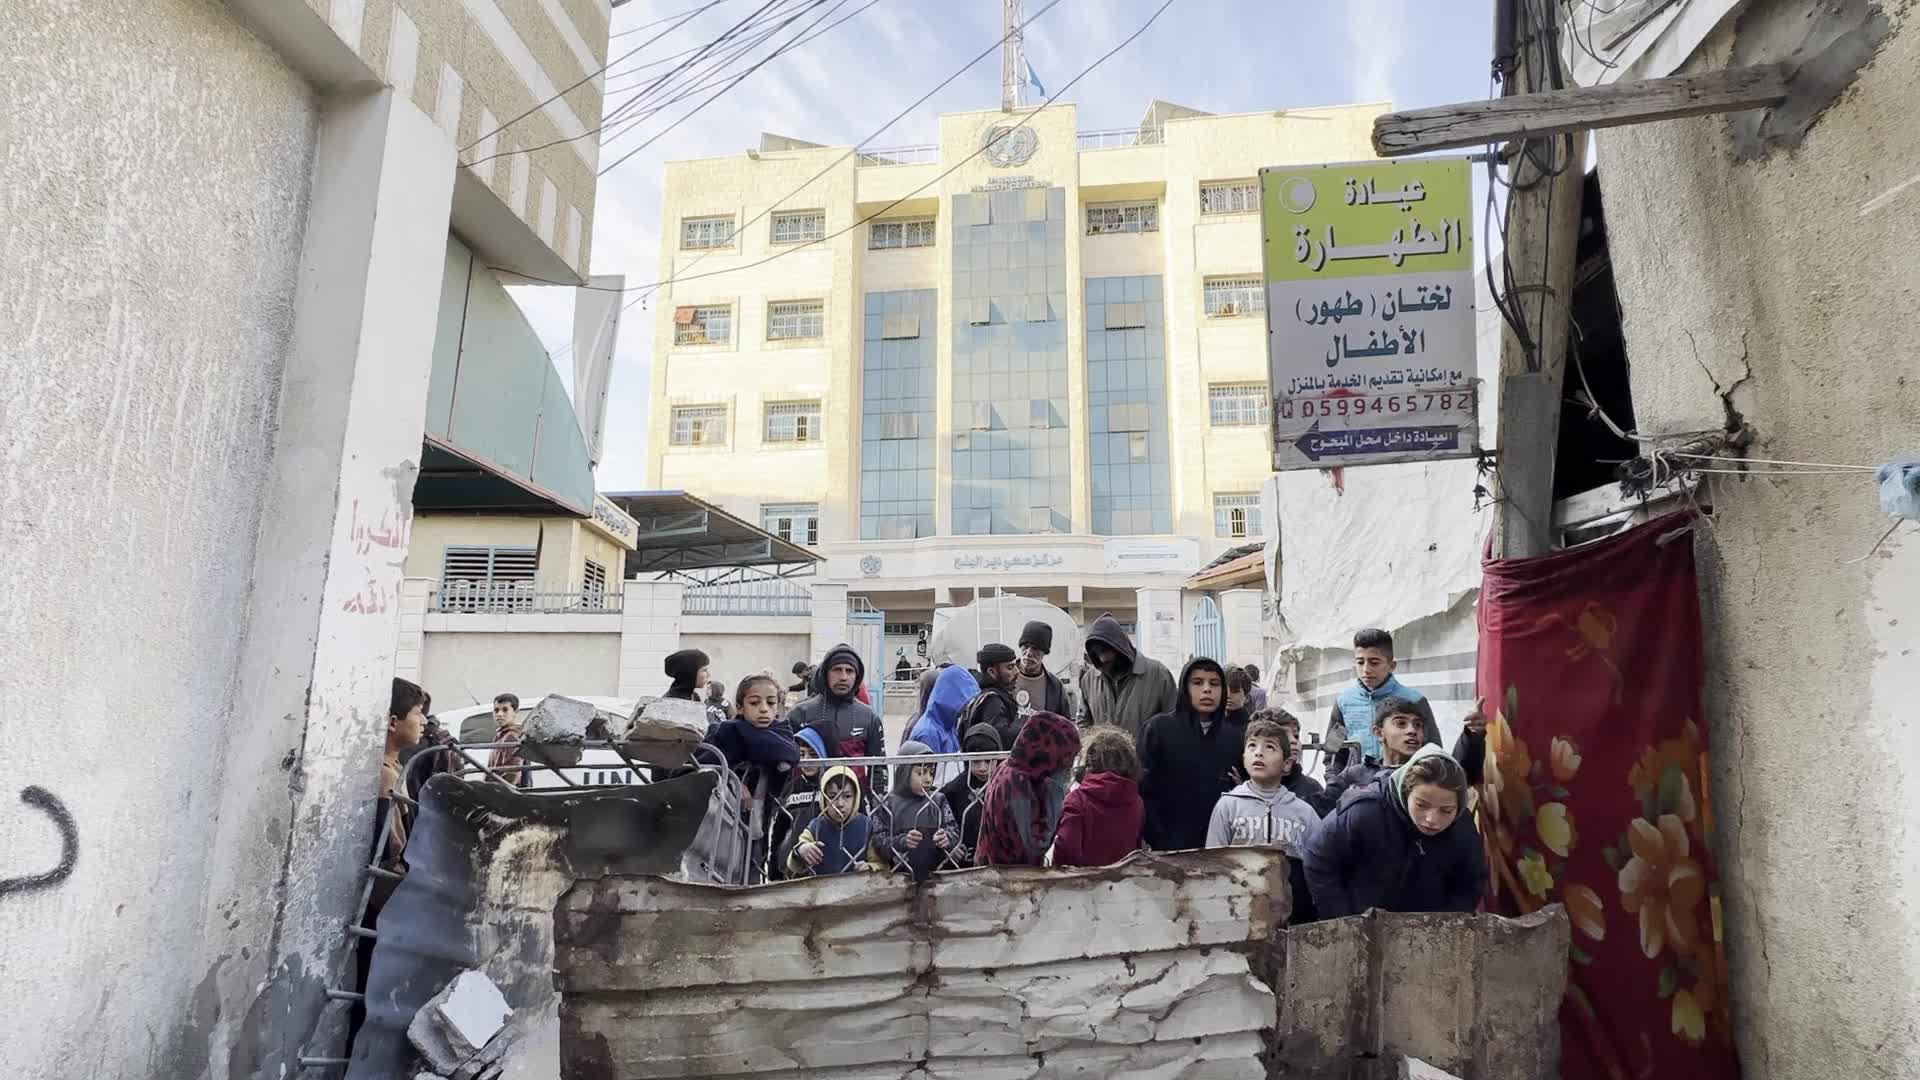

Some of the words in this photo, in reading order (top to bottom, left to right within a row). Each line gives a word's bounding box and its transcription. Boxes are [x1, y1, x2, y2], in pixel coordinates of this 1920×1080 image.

[1344, 176, 1426, 212] عيادة
[1295, 217, 1461, 271] الطهارة
[1382, 284, 1452, 321] لختان
[1325, 324, 1425, 367] الأطفال
[1288, 377, 1325, 396] بالمنزل
[1329, 373, 1366, 389] الخدمة
[1369, 371, 1404, 390] تقديم
[1450, 371, 1462, 386] مع
[1353, 434, 1381, 448] محل
[1383, 432, 1409, 447] داخل
[583, 769, 632, 785] UN
